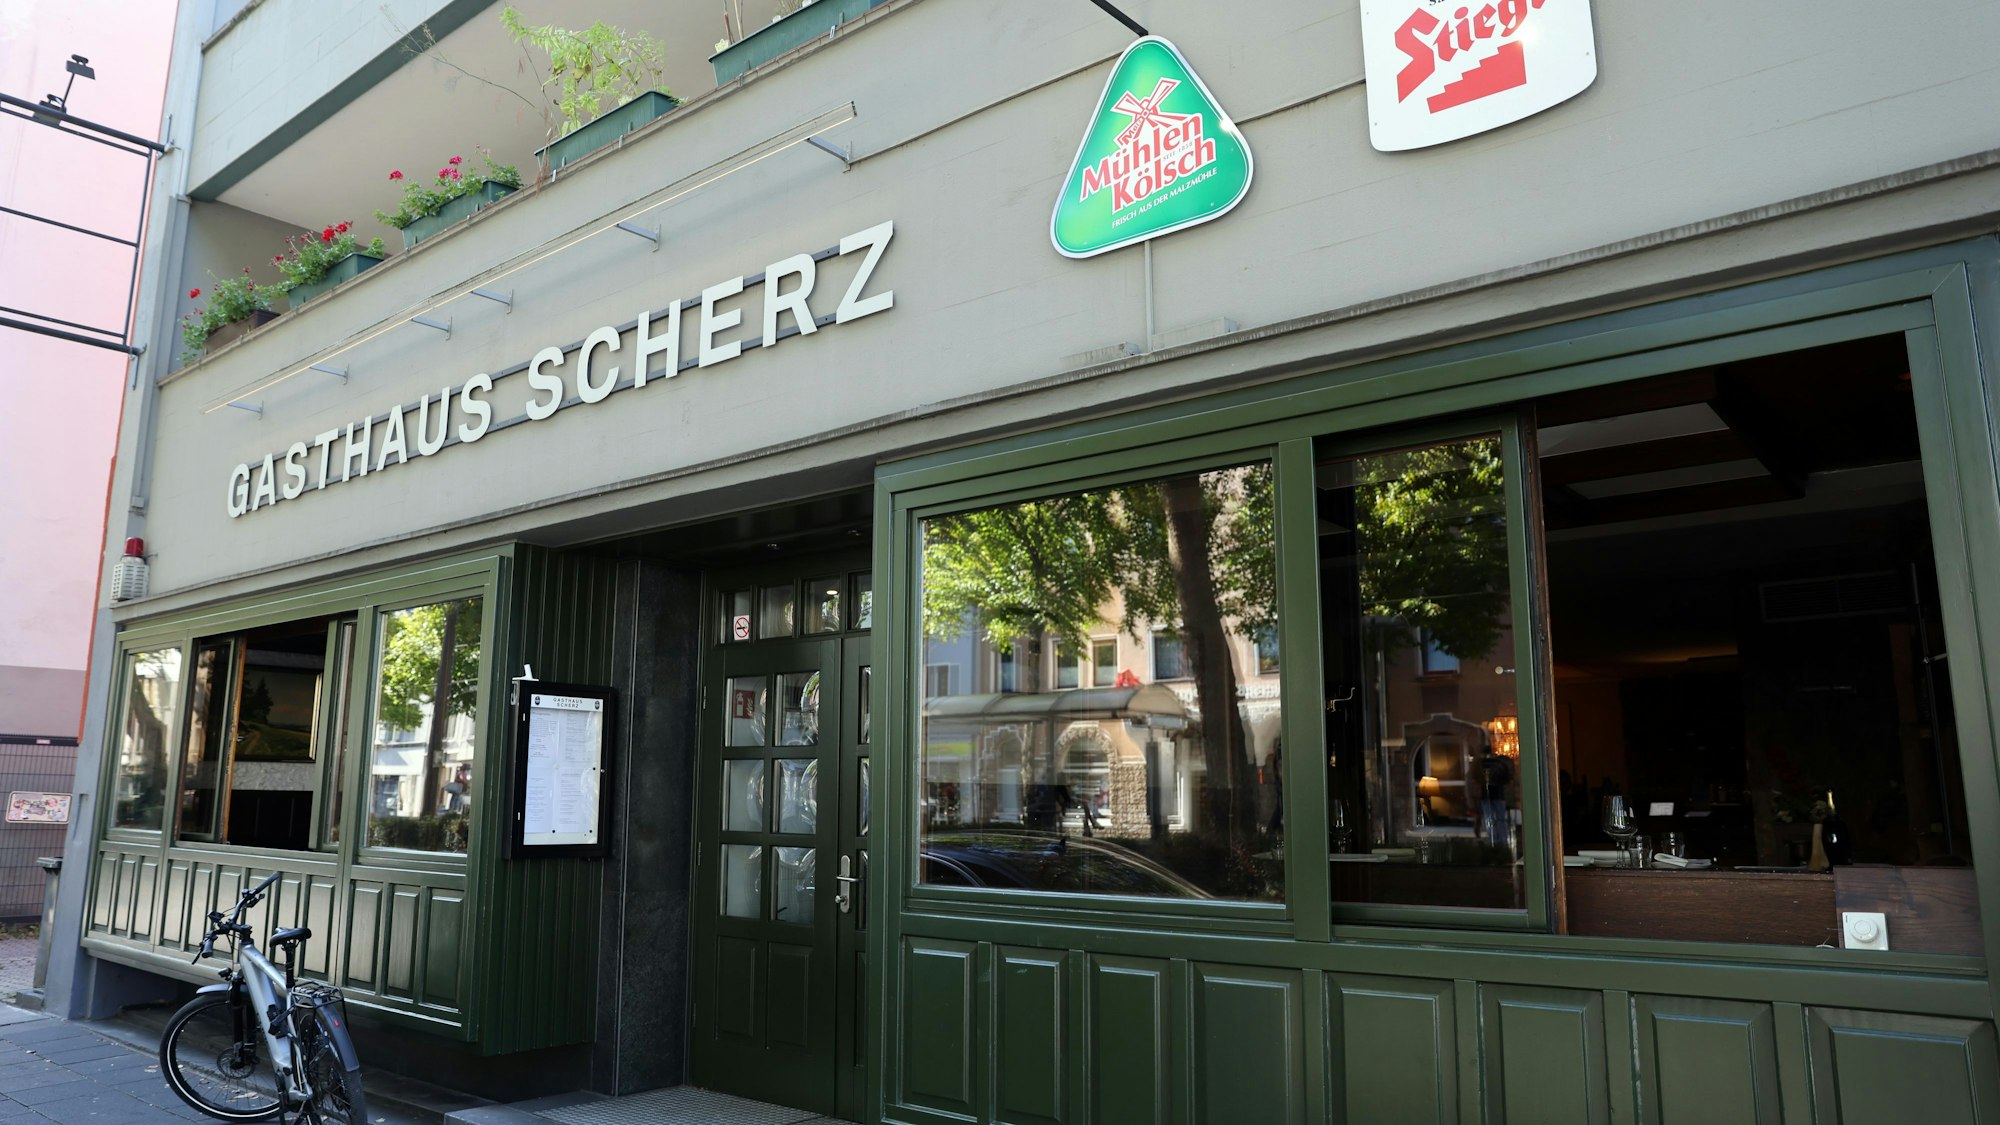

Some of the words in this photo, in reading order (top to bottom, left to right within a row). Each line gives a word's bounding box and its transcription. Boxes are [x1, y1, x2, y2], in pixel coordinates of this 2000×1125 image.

[1394, 0, 1547, 104] Stieg
[1082, 114, 1202, 200] Mühlen
[1111, 210, 1137, 229] FRISCH
[1138, 202, 1153, 215] AUS
[1153, 194, 1169, 206] DER
[1169, 167, 1218, 198] MALZMÜHLE
[1112, 136, 1215, 212] Kölsch
[227, 372, 493, 519] GASTHAUS
[525, 219, 895, 421] SCHERZ
